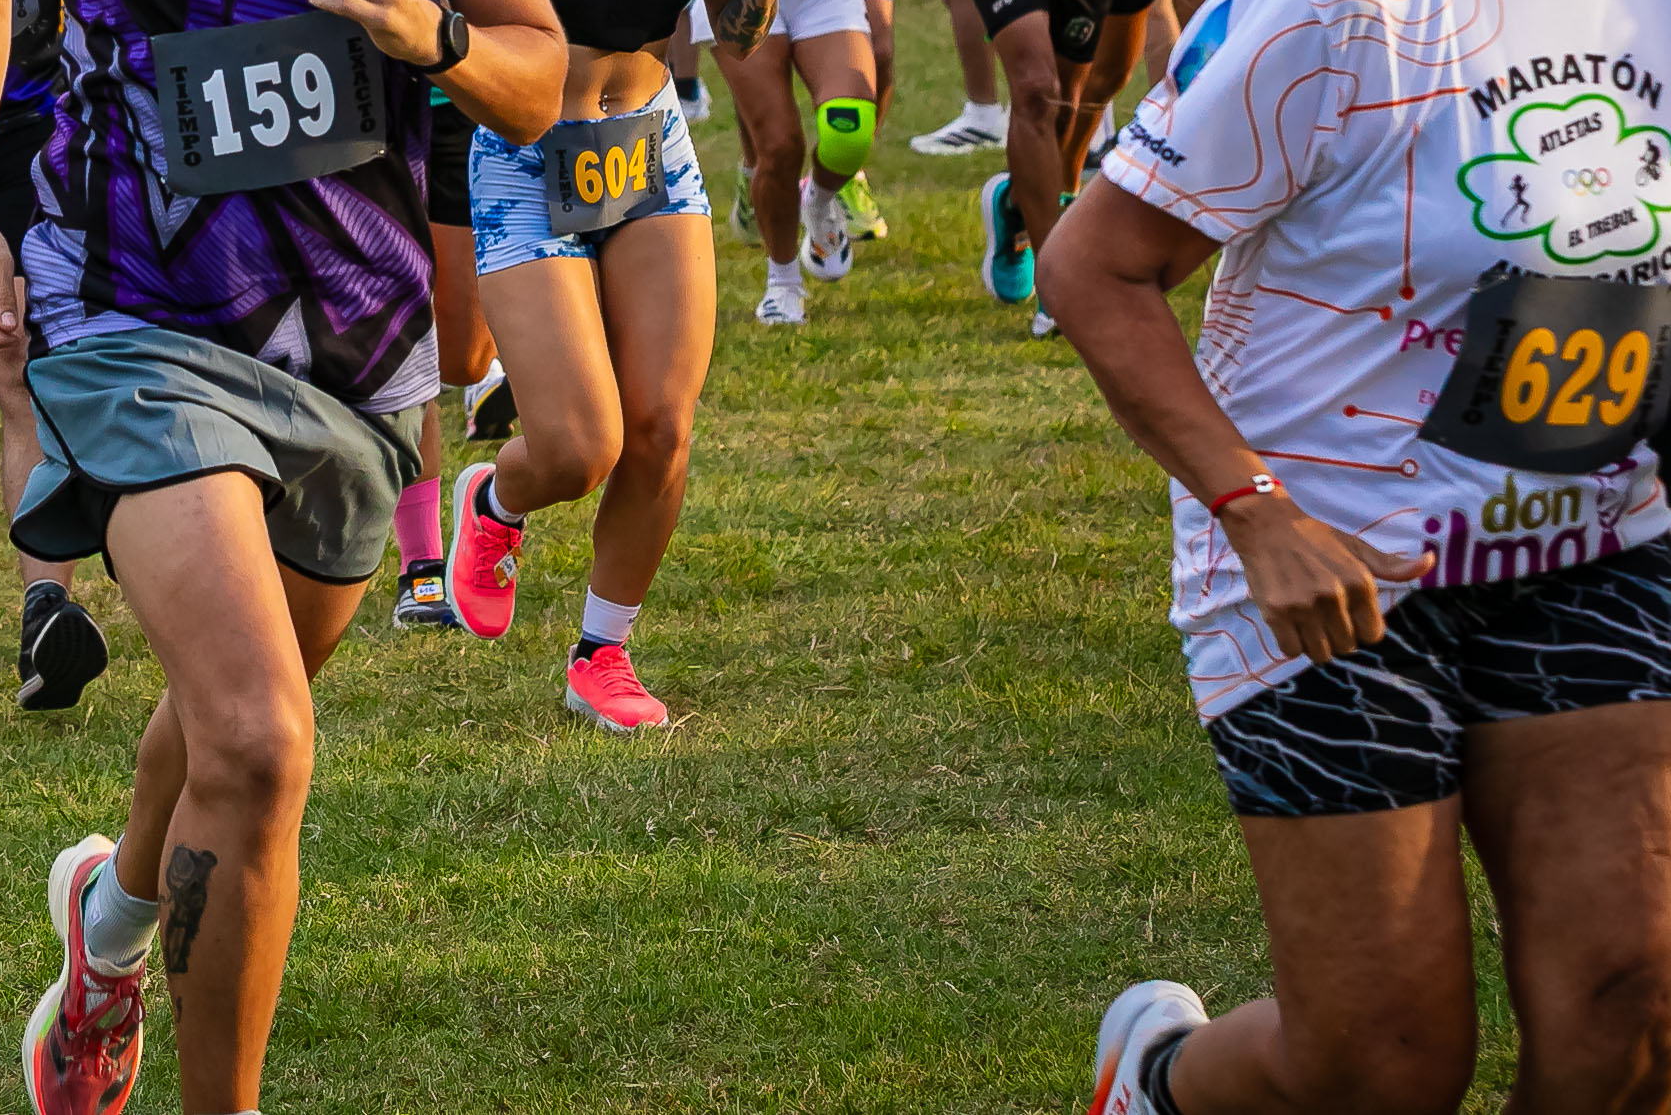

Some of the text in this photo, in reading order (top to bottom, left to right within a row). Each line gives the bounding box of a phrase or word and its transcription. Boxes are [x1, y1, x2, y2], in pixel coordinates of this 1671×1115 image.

[169, 66, 202, 167] TIEMPO
[202, 52, 336, 157] 159
[347, 36, 377, 134] EXACTO
[1470, 54, 1663, 119] MARATÓN
[646, 132, 659, 195] EXACTO
[1540, 112, 1603, 155] ATLETAS
[575, 137, 647, 204] 604
[1500, 327, 1650, 426] 629
[1481, 470, 1584, 534] don
